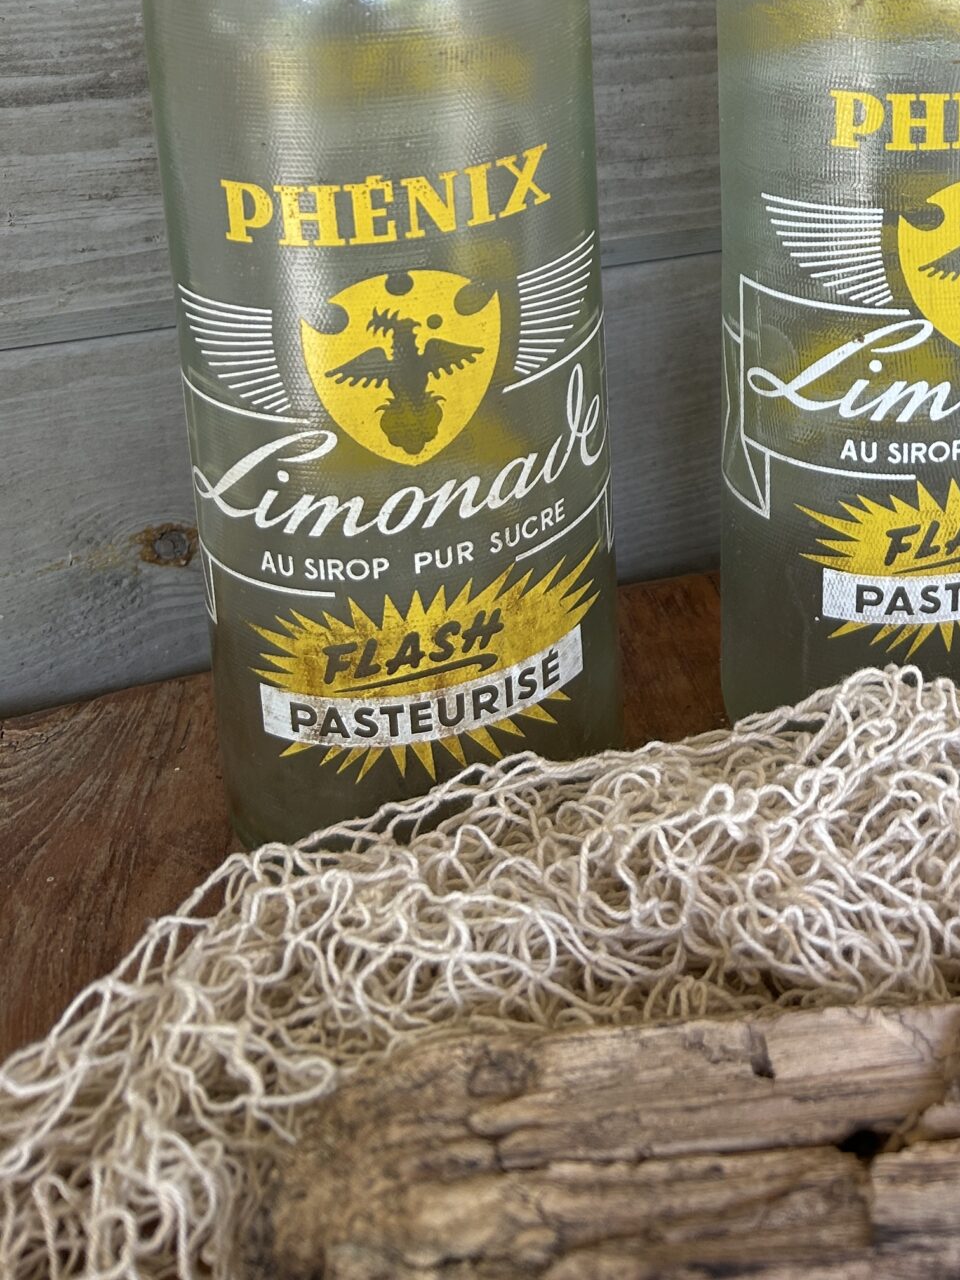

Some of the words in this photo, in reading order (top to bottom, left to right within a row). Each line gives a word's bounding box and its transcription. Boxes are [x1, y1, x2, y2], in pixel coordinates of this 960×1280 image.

[221, 143, 551, 247] PHÉNIX
[192, 362, 608, 537] Limonade
[840, 439, 879, 463] AU
[260, 550, 295, 577] AU
[304, 557, 390, 581] SIROP
[413, 540, 475, 575] PUR
[489, 497, 567, 555] SUCRE
[322, 607, 506, 685] FLASH
[289, 649, 563, 740] PASTEURISÉ
